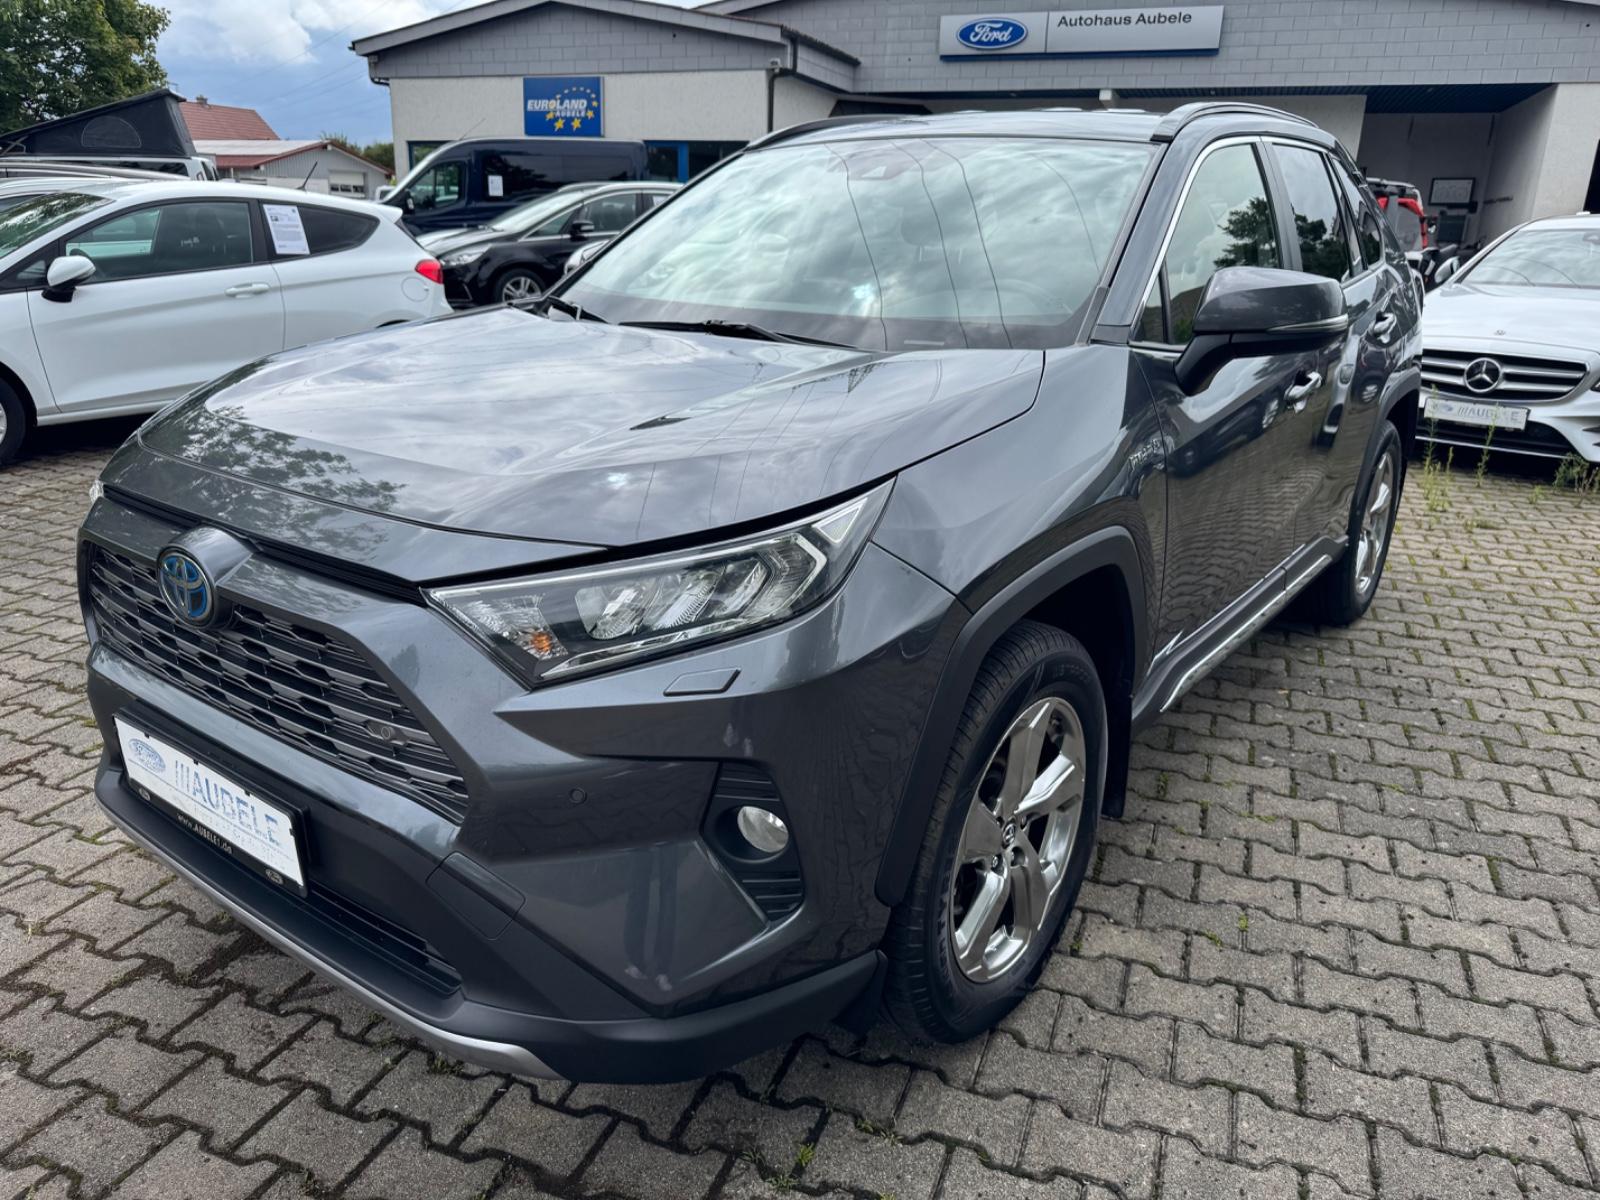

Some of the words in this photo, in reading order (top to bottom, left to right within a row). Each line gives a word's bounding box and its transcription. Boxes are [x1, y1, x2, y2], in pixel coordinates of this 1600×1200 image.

[1057, 14, 1132, 27] Autohaus
[1135, 12, 1192, 25] Aubele
[970, 22, 1013, 42] Ford
[527, 98, 587, 111] EUROLAND
